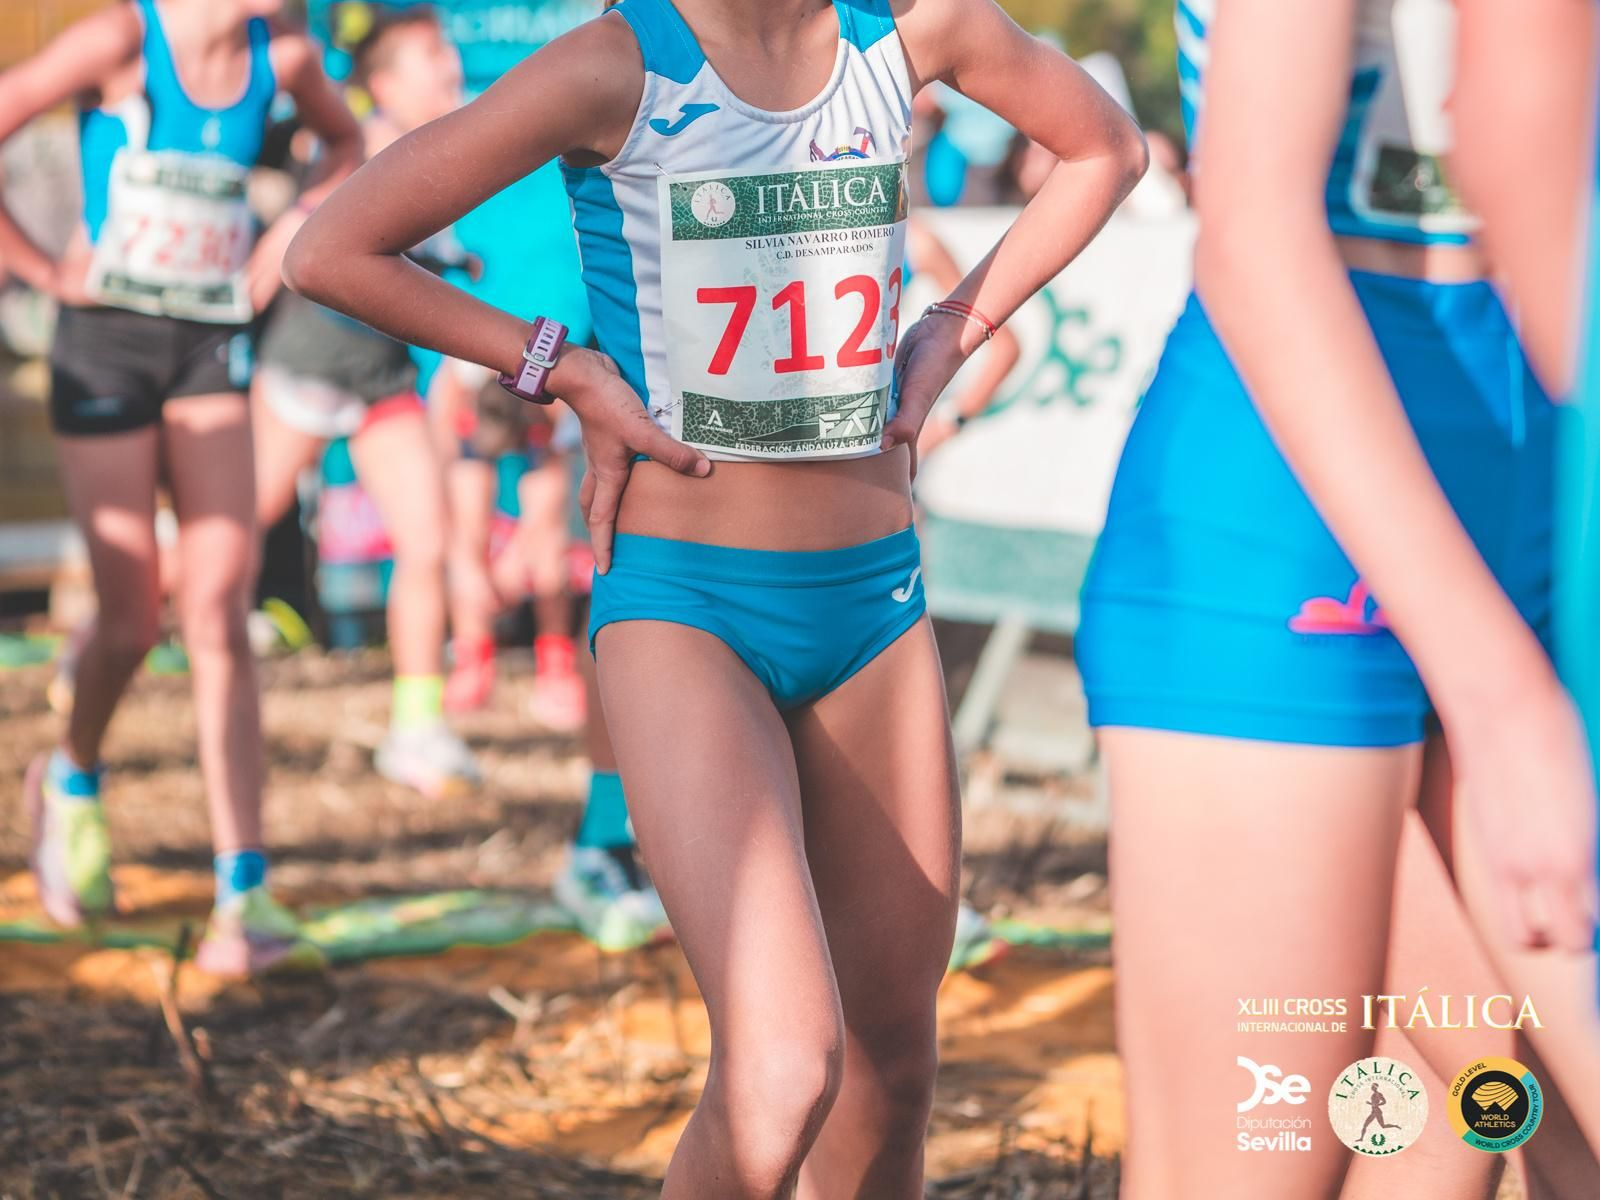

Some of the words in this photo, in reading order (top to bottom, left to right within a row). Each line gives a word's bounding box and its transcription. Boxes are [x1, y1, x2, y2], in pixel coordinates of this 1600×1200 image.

[757, 174, 888, 215] ITÁLICA
[758, 211, 823, 224] INTERNATIONAL
[826, 209, 852, 218] CROSS
[854, 207, 888, 215] COUNTRY
[745, 238, 785, 250] SILVIA
[787, 231, 848, 246] NAVARRO
[851, 226, 894, 241] ROMERO
[776, 250, 794, 260] C.D.
[795, 243, 874, 258] DESAMPARADOS
[697, 267, 902, 375] 7123
[735, 442, 792, 453] FEDERACIÓN
[796, 441, 845, 452] ANDALUZA
[848, 439, 860, 447] DE
